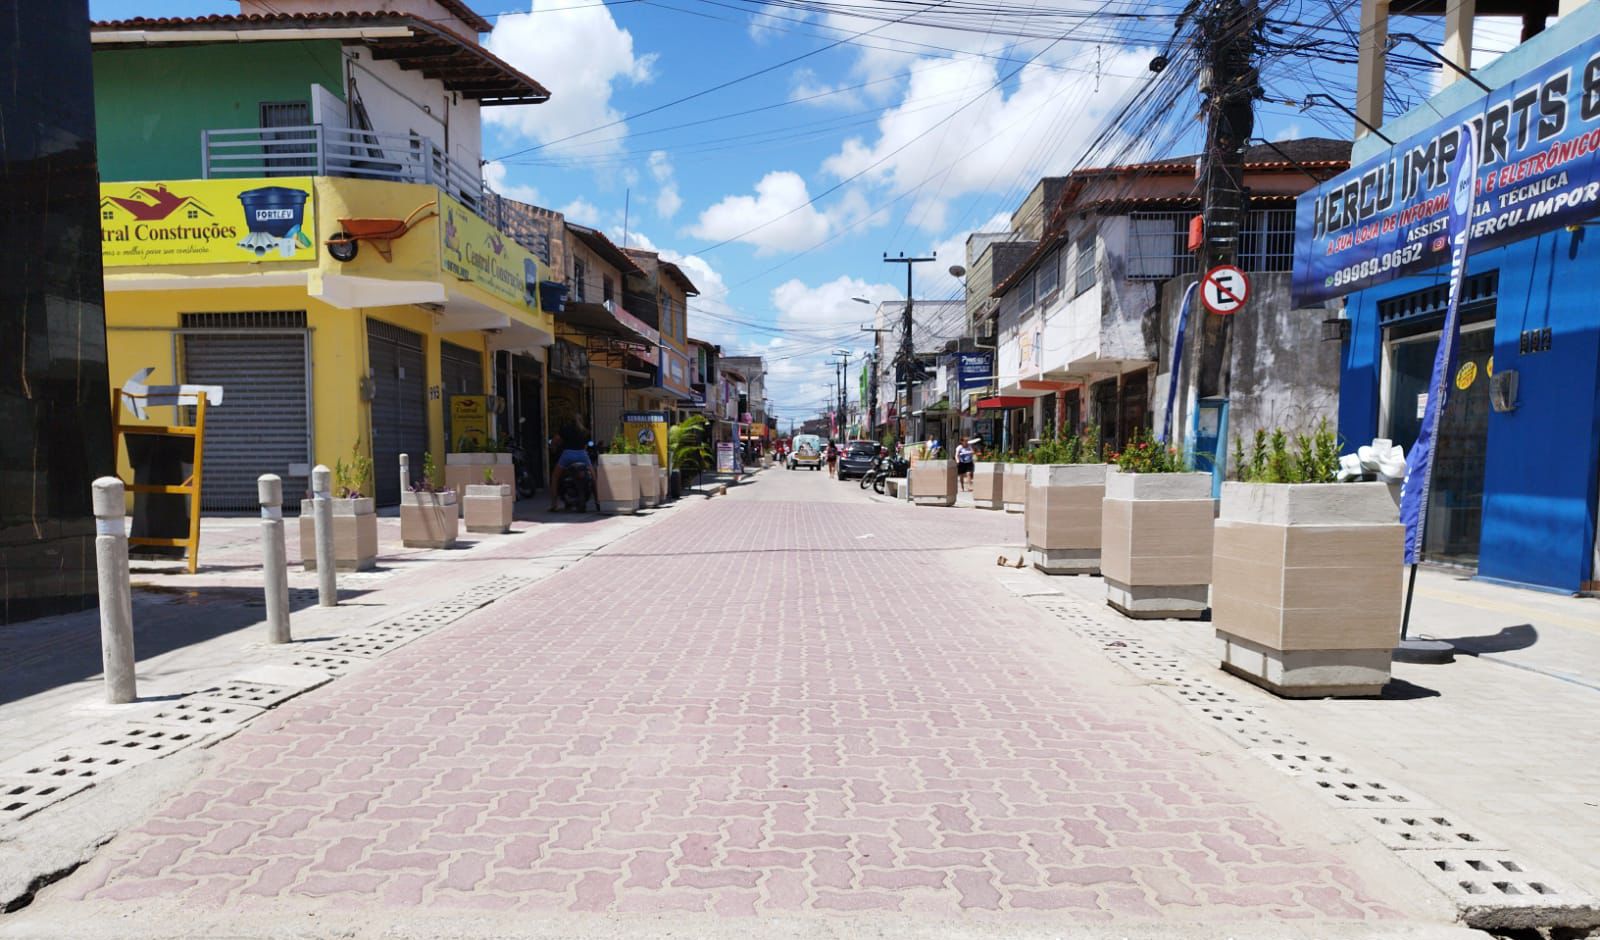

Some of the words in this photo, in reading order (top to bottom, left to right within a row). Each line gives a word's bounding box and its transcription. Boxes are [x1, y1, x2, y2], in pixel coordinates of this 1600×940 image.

[1313, 159, 1396, 240] HERCU
[1327, 240, 1334, 256] A
[1336, 232, 1353, 252] SUA
[1355, 223, 1379, 244] LOJA
[1382, 217, 1396, 235] DE
[1486, 171, 1497, 192] E
[1499, 127, 1600, 189] ELETRÔNICO
[1499, 171, 1568, 208] TÉCNICA
[256, 209, 294, 220] FORTLEV
[134, 223, 237, 244] Construções
[1333, 242, 1422, 288] 99989.9652
[1216, 276, 1234, 304] E
